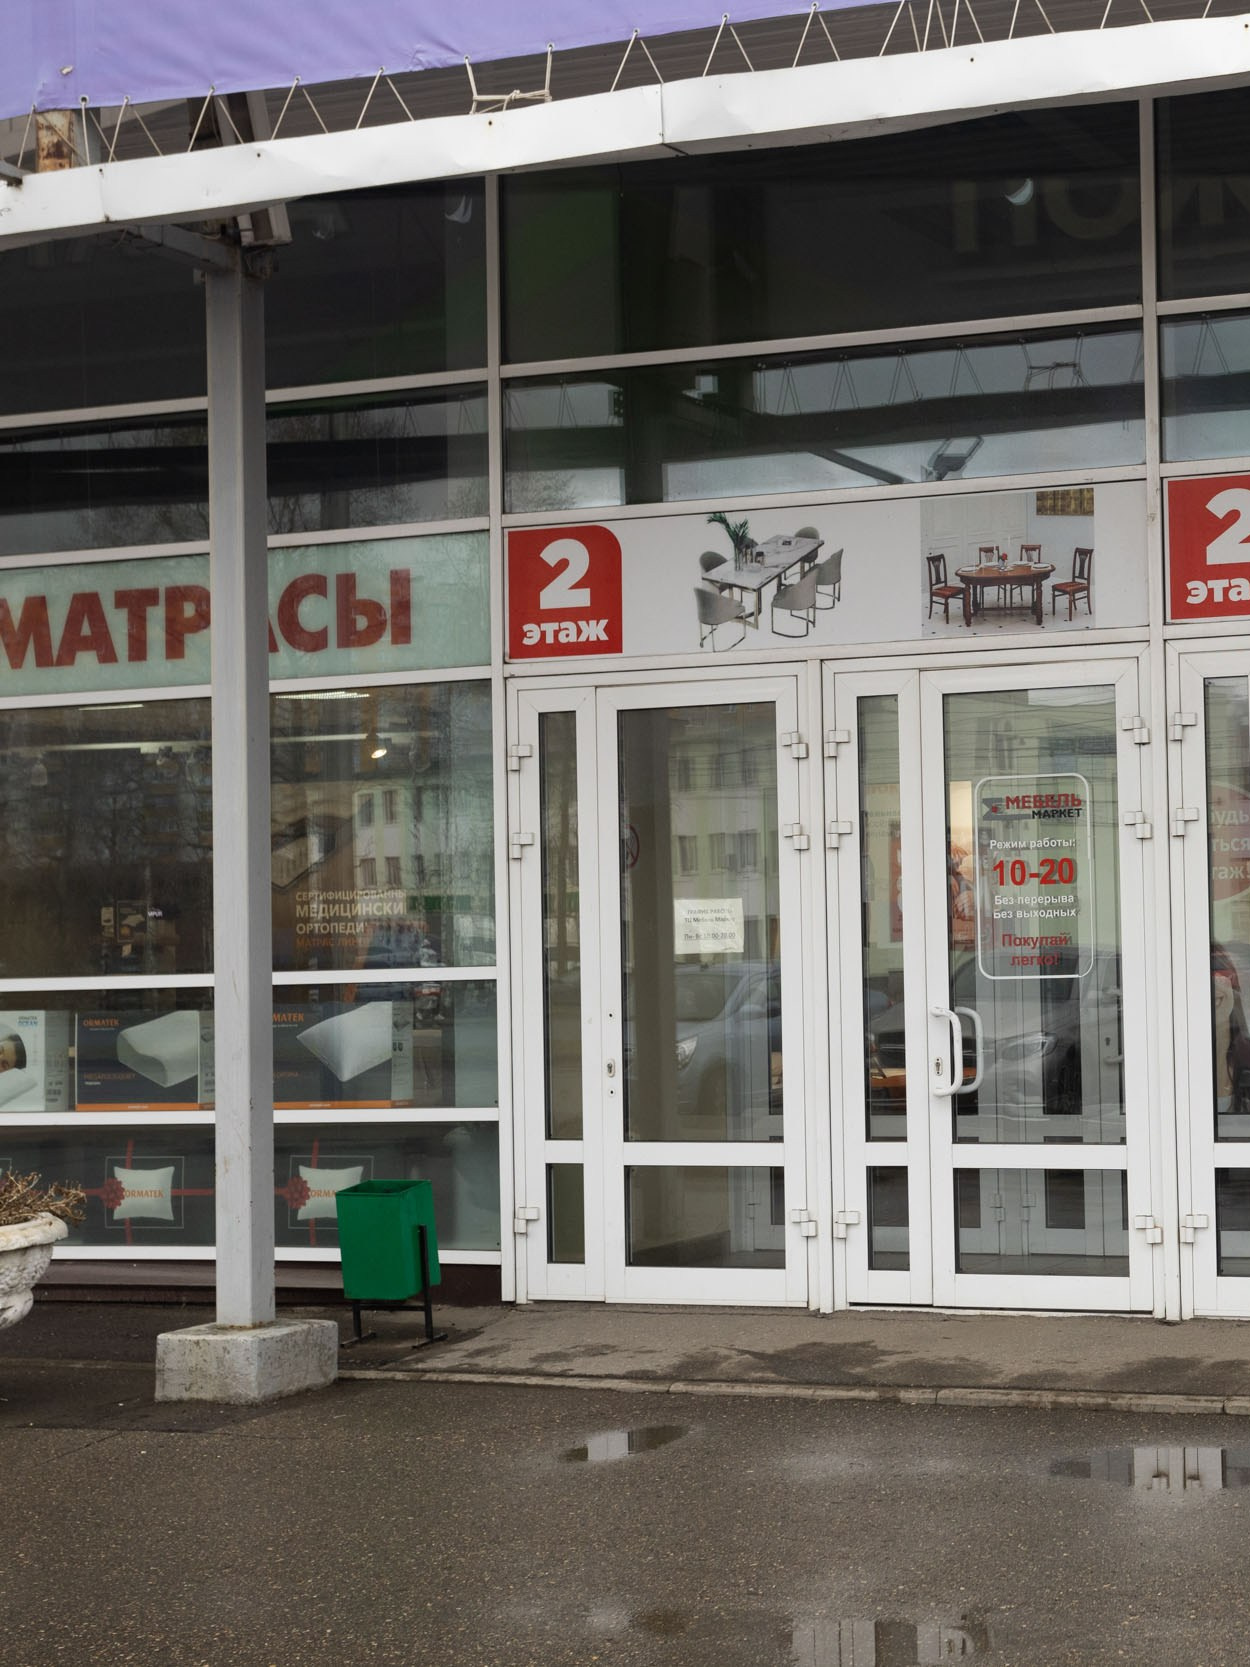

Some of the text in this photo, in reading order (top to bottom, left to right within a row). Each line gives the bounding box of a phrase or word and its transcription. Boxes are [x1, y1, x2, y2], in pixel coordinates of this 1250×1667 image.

[539, 538, 591, 610] 2
[0, 568, 411, 670] МАТРСЫ
[522, 619, 609, 646] этаж
[1005, 792, 1082, 810] МЕБЕЛЬ
[1032, 808, 1083, 819] МАРКЕТ
[989, 837, 1076, 850] Режим работы:
[992, 857, 1076, 887] 10-20
[994, 894, 1074, 906] Без перерыва
[993, 908, 1077, 919] Без выходных
[1002, 931, 1069, 950] Покупай
[1010, 951, 1061, 967] легко!
[124, 1189, 164, 1199] ORMATEK
[310, 1189, 336, 1198] ORMA
